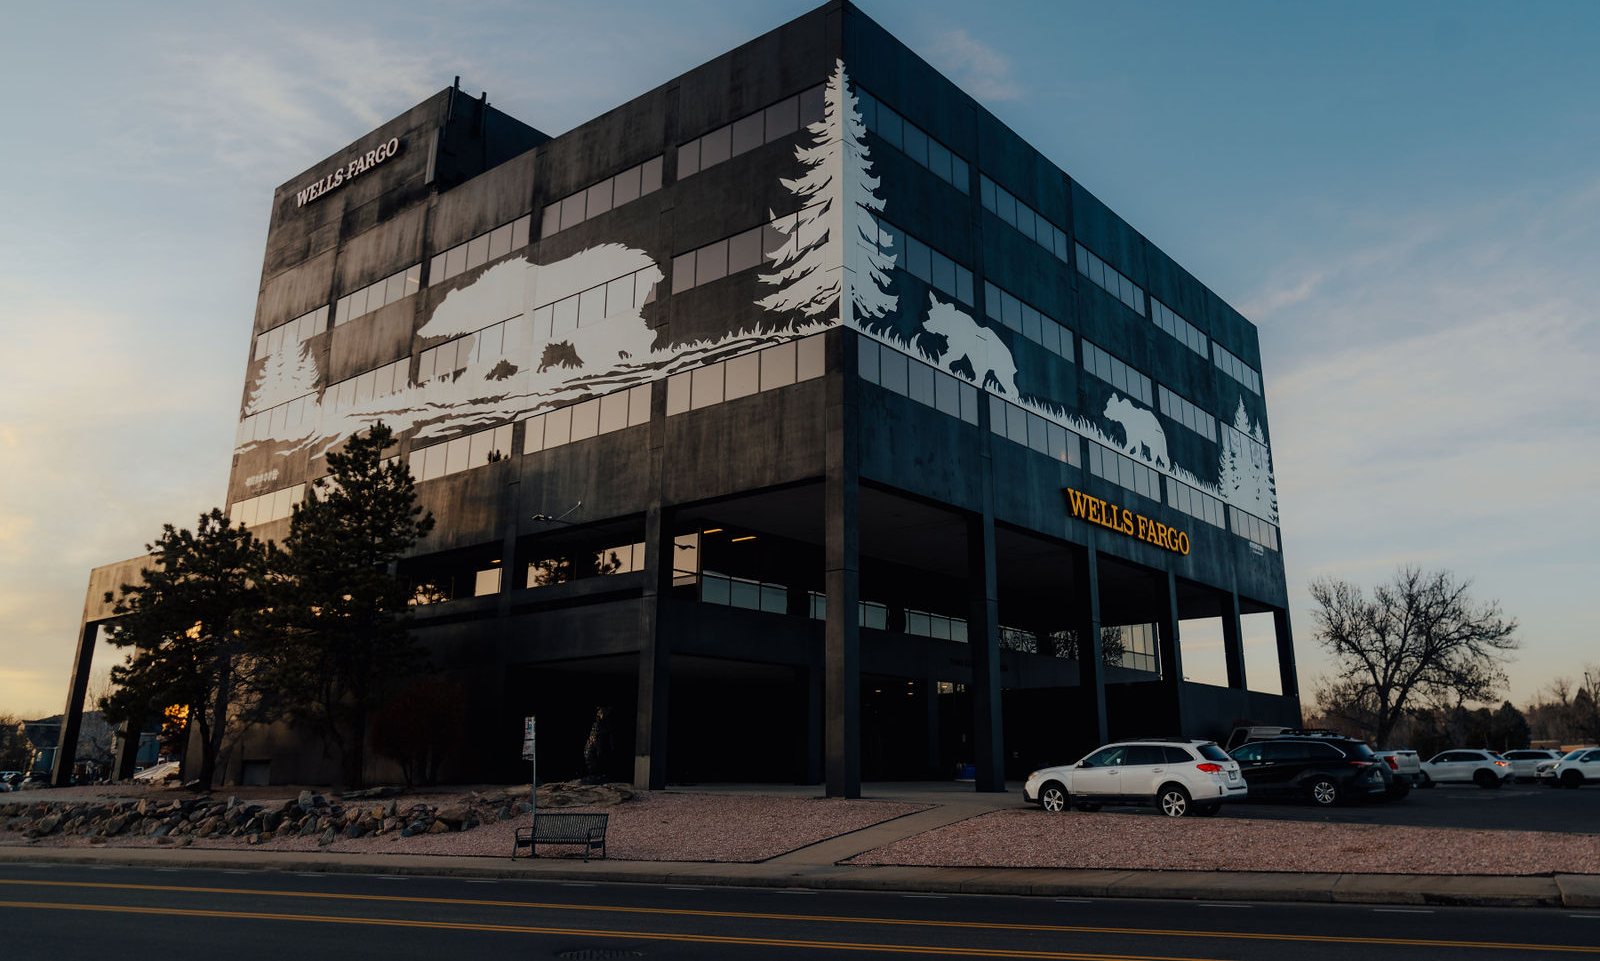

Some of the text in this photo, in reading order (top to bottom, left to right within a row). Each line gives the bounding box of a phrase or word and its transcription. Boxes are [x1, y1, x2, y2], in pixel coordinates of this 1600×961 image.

[296, 137, 399, 208] WELLS FARGO
[1067, 487, 1190, 556] WELLS FARGO
